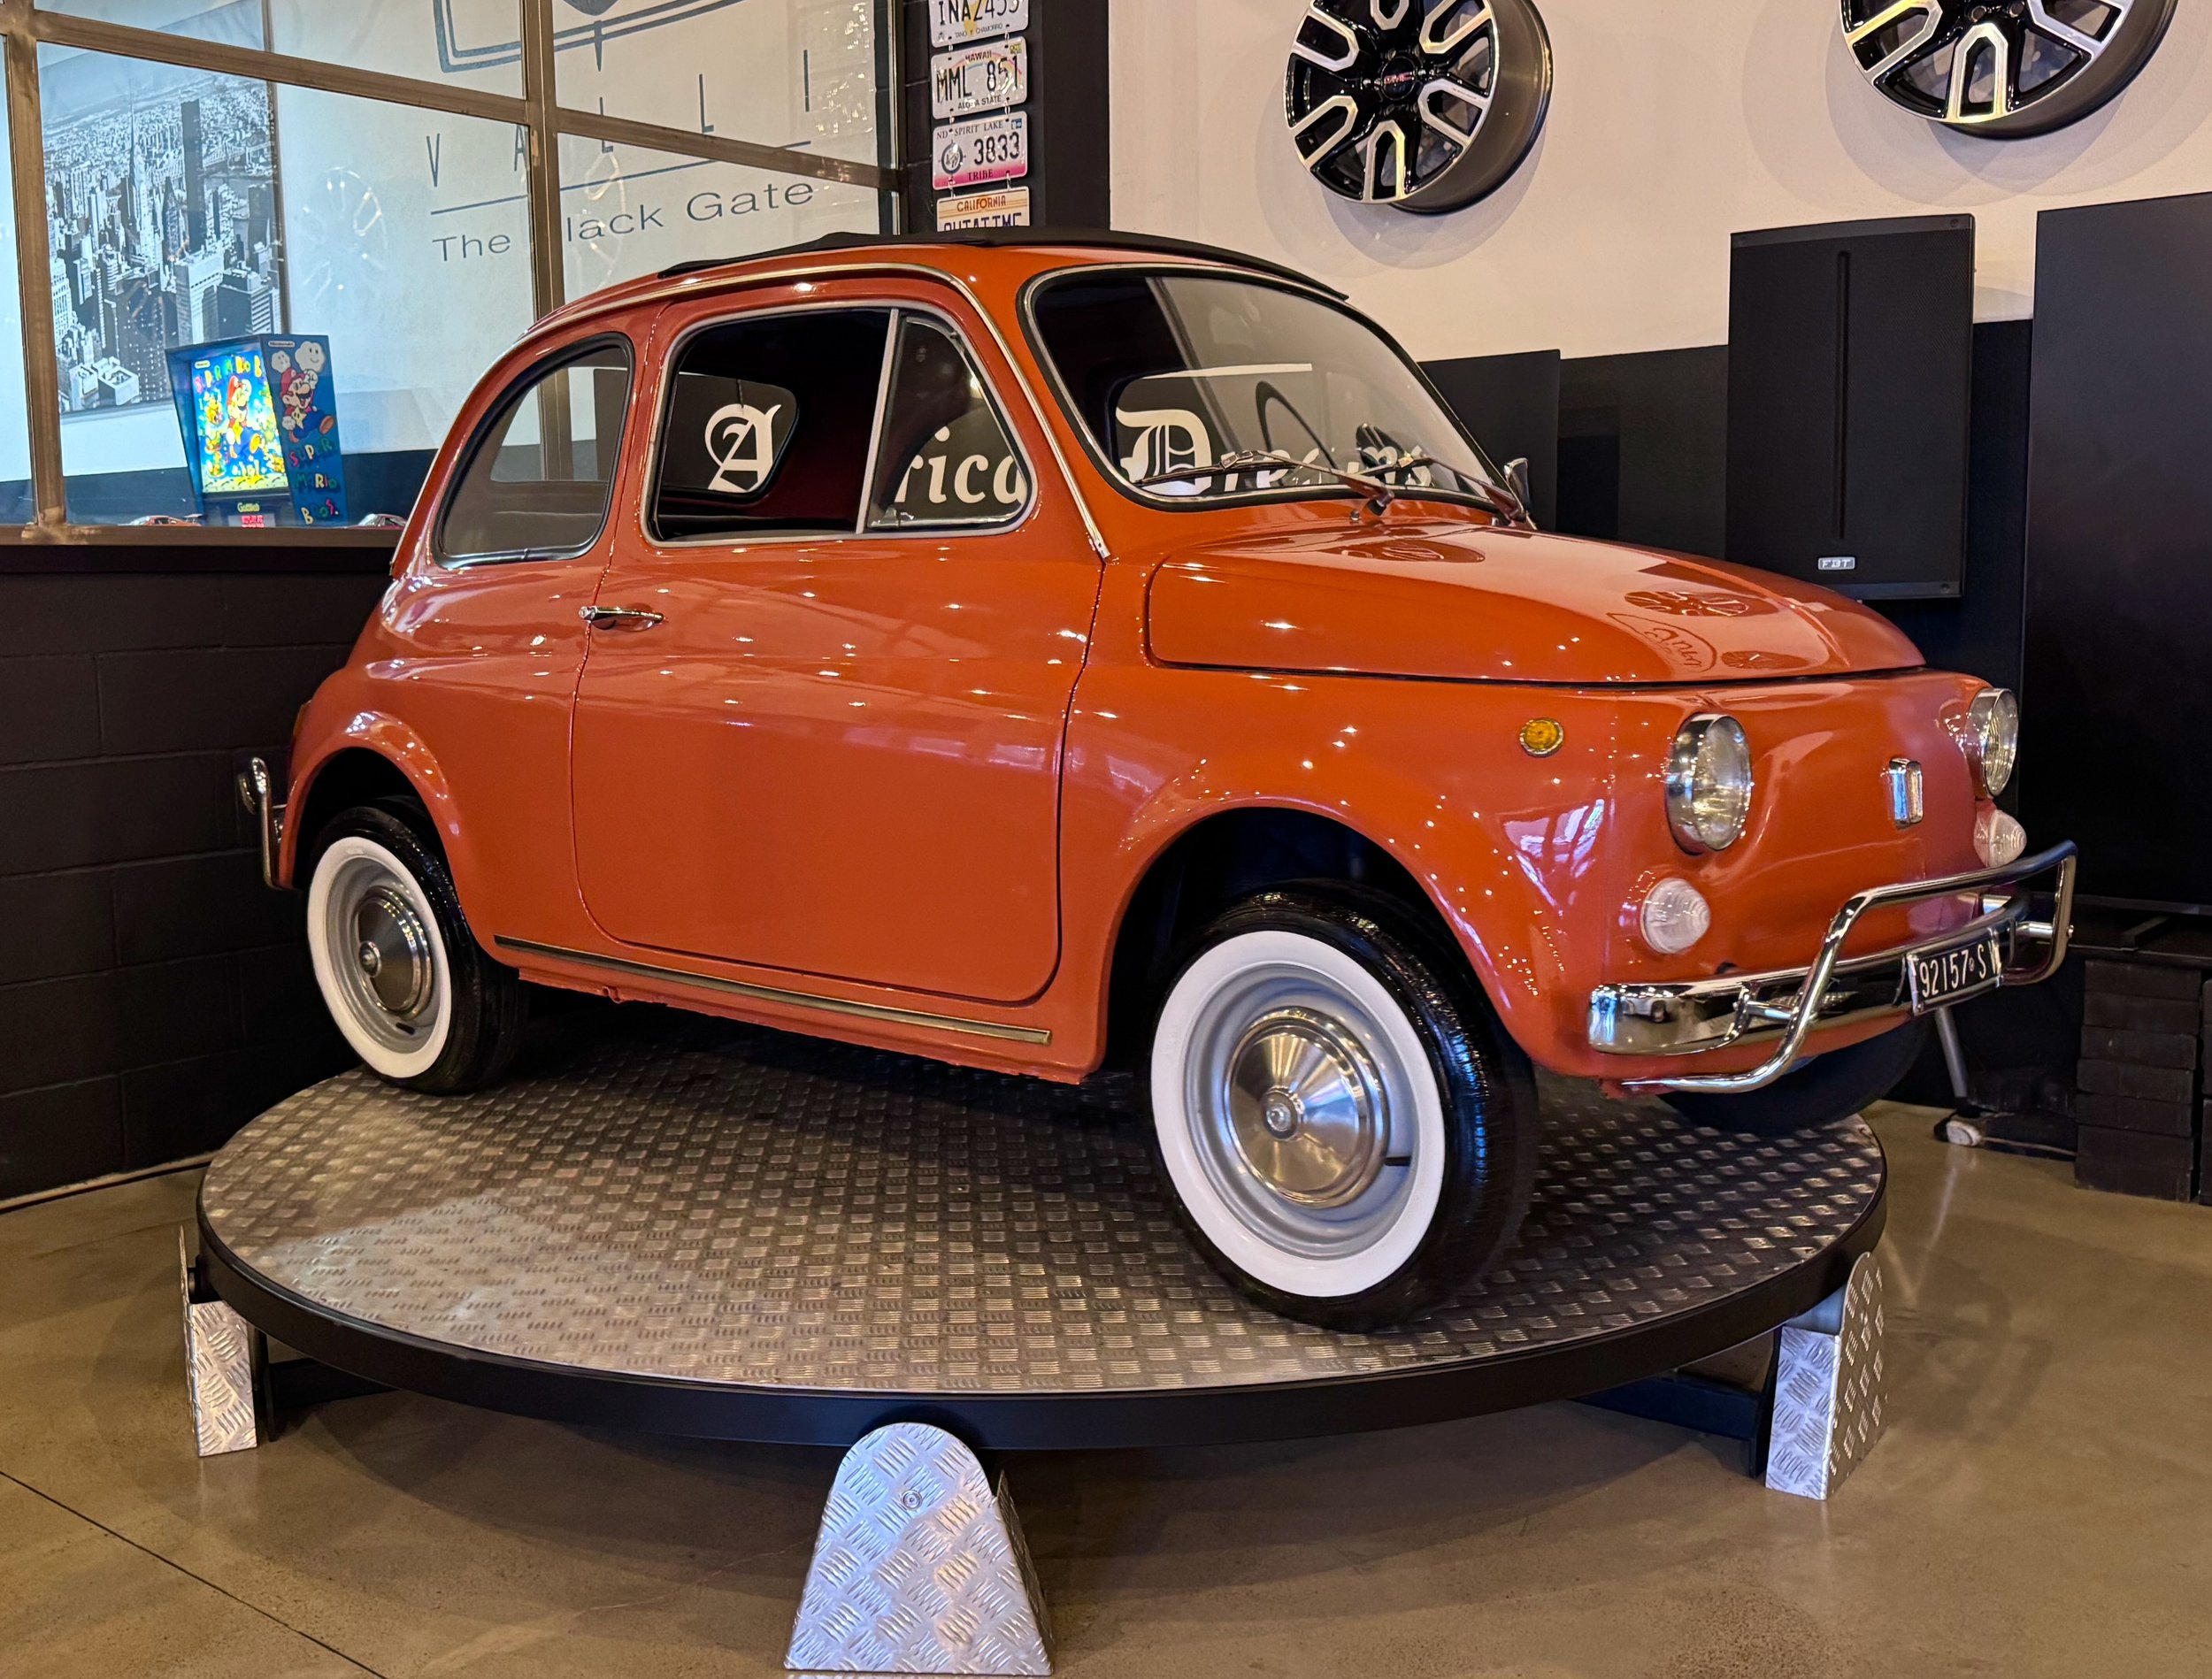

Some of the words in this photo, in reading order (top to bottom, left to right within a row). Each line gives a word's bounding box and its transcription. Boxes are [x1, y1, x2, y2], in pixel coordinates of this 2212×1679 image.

[964, 50, 992, 62] HAWAII
[936, 65, 972, 104] MML
[987, 55, 1018, 92] 851
[957, 99, 979, 110] ALOA
[981, 95, 1002, 105] STATE
[936, 131, 949, 140] ND
[955, 125, 979, 136] SPIRIT
[984, 120, 1003, 131] LAKE
[973, 132, 1019, 165] 3833
[968, 169, 994, 181] TRIBE
[956, 195, 1006, 212] CALIFORNIA
[432, 234, 511, 262] The
[566, 204, 664, 242] lack
[686, 182, 813, 222] Gate
[289, 437, 333, 467] SUPR
[1919, 949, 1969, 998] 92157
